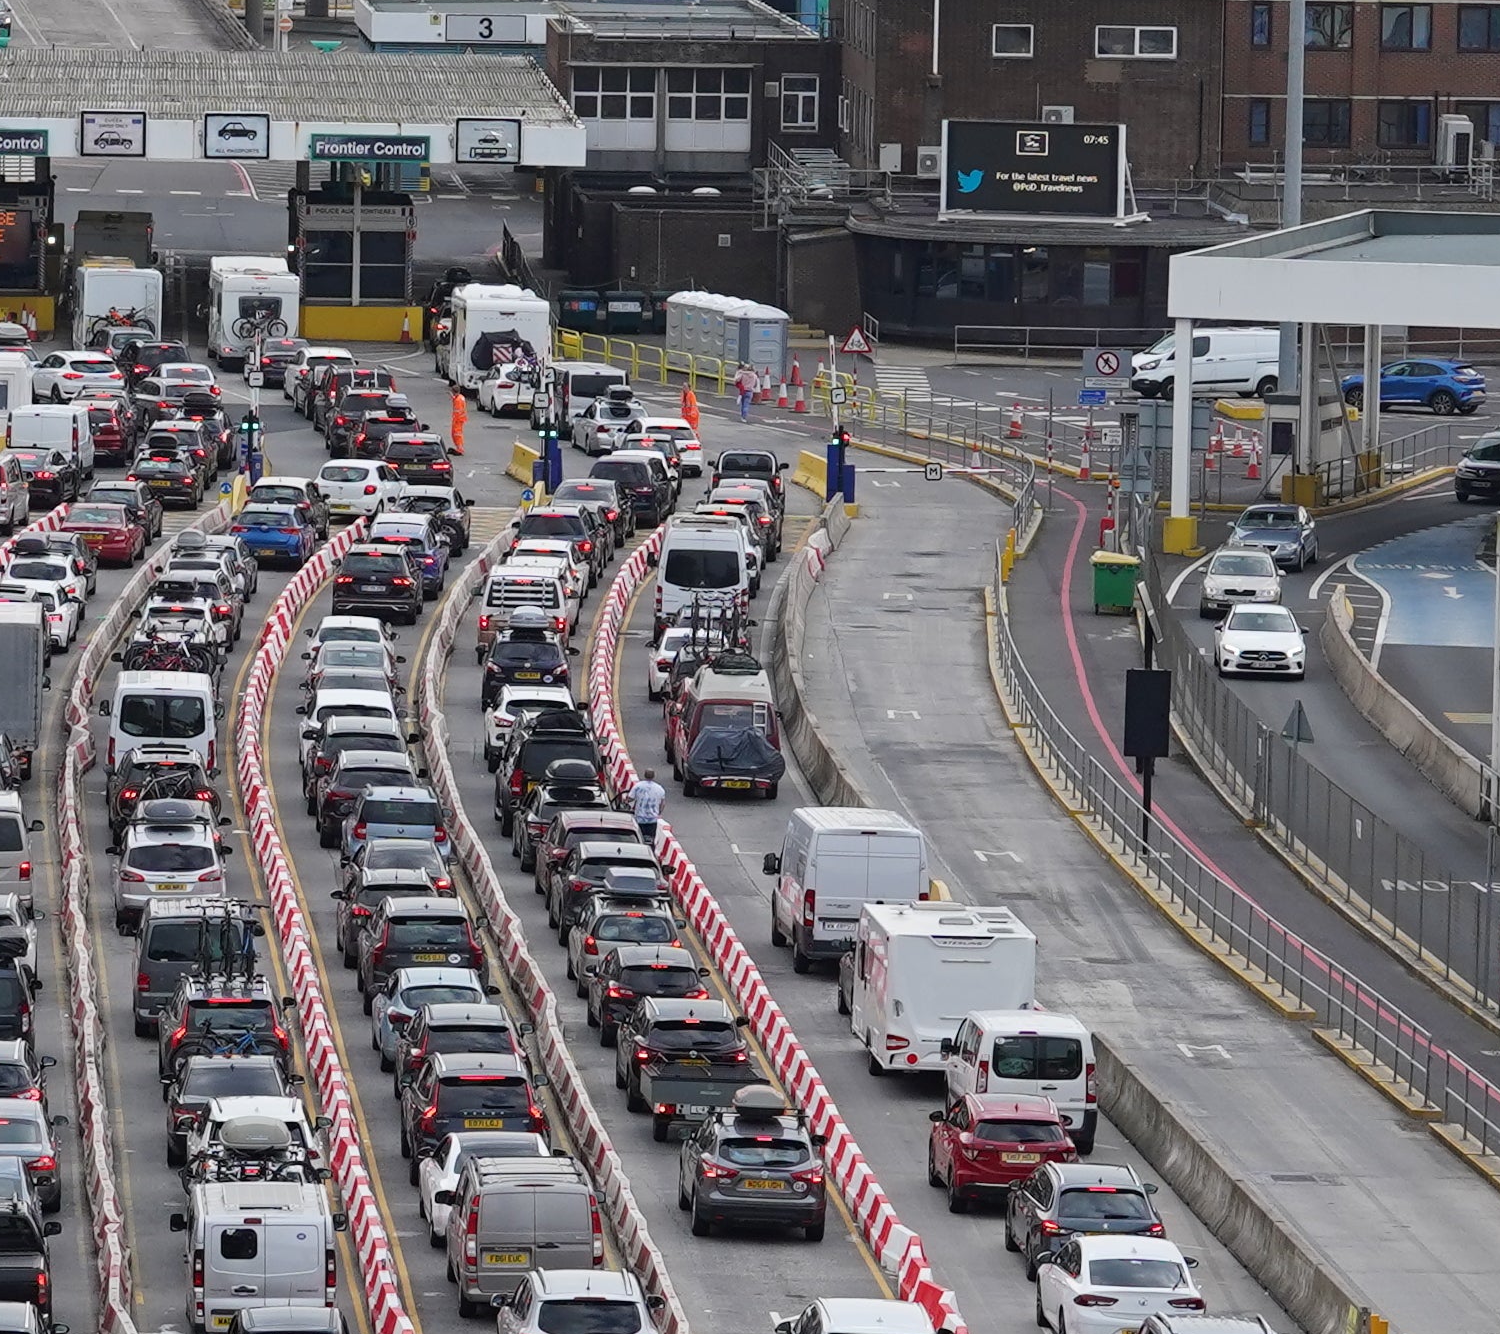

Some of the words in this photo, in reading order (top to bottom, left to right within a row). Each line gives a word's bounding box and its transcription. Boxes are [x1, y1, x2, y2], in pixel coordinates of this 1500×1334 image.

[478, 18, 493, 39] 3
[1083, 135, 1109, 145] 07:45
[315, 141, 369, 155] Frontier
[373, 141, 426, 156] Control
[996, 172, 1010, 182] For
[1011, 172, 1025, 182] the
[1027, 173, 1050, 183] latest
[1051, 174, 1075, 184] travel
[1076, 176, 1098, 184] news
[928, 466, 938, 477] M
